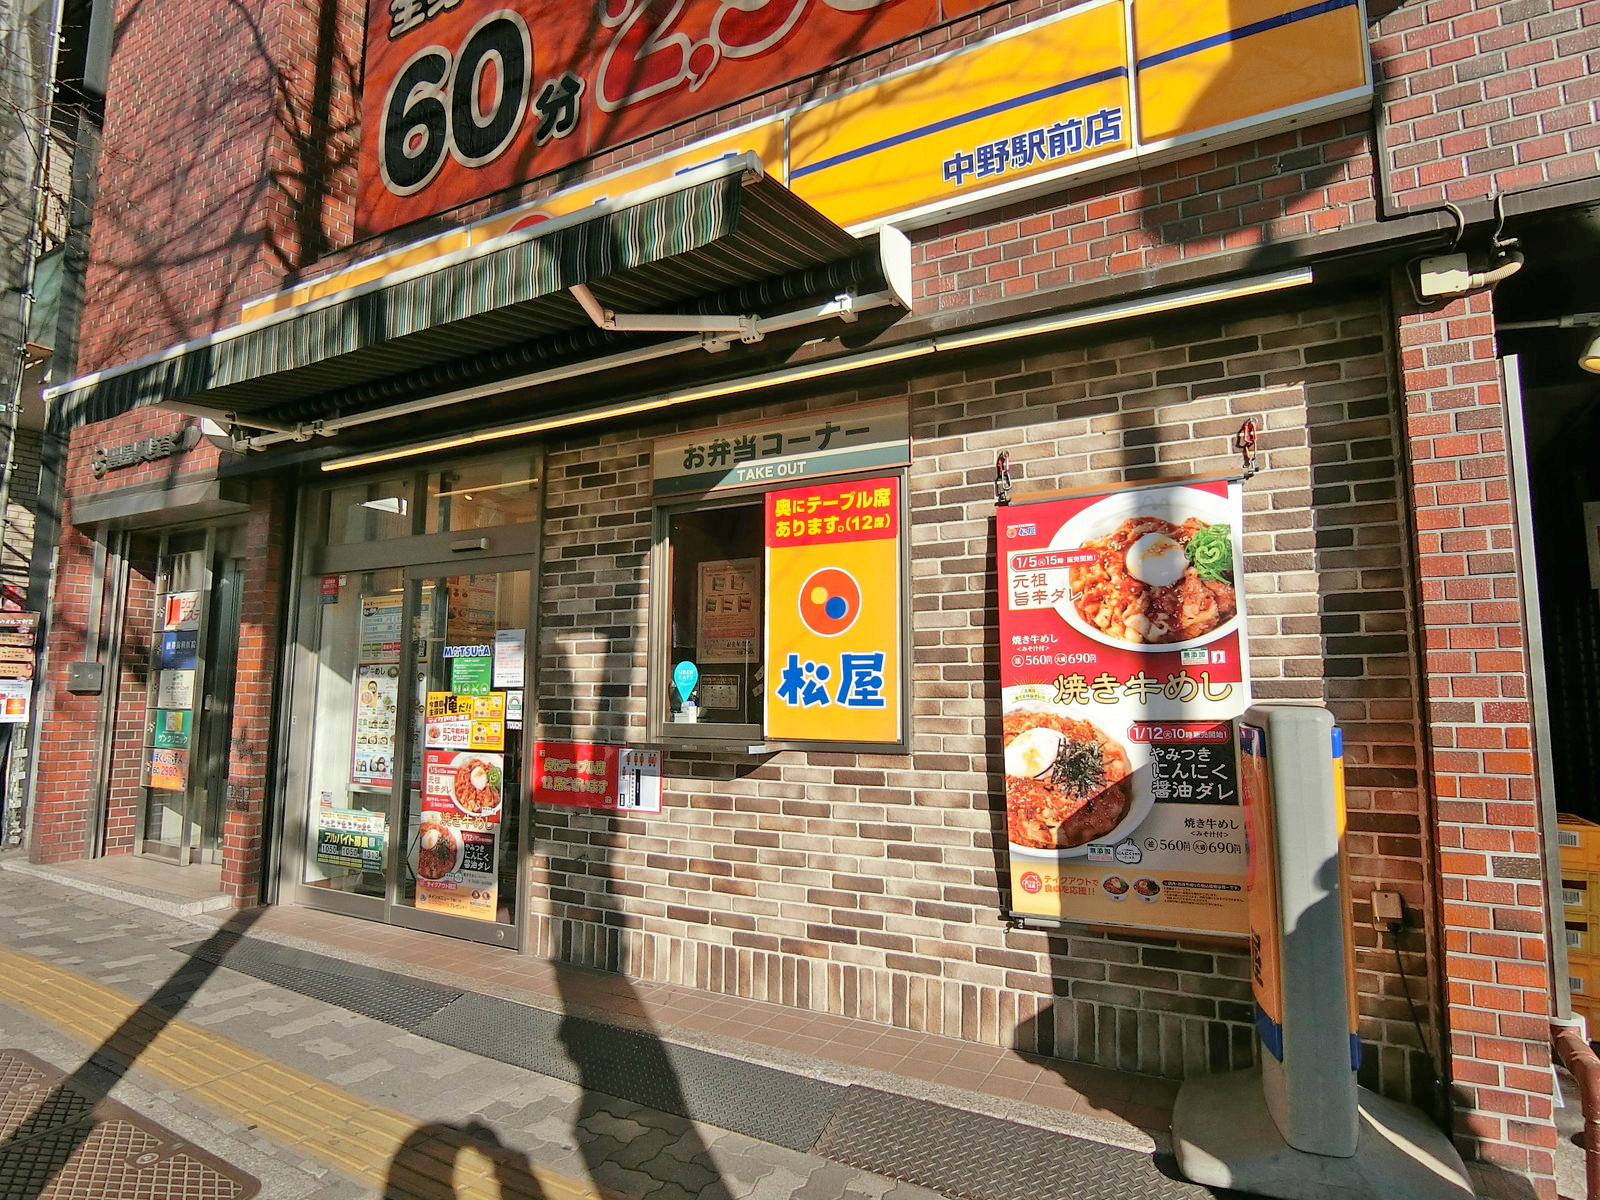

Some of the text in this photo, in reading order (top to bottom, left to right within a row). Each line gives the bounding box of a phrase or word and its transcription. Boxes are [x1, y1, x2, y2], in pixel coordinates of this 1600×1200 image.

[942, 106, 1124, 186] 中野駅前店
[683, 421, 871, 470] お弁当コーナー
[736, 462, 807, 482] TAKE OUT
[775, 488, 891, 518] 奥にテーブル席
[775, 514, 891, 538] あります。(12席)
[1012, 573, 1048, 588] 元祖
[1014, 586, 1083, 606] 旨辛ダレ
[1012, 633, 1059, 645] 焼き牛めし
[443, 645, 491, 658] MATSUYA
[776, 651, 888, 709] 松屋
[1053, 669, 1233, 705] 焼き牛めし
[1150, 746, 1211, 762] やみつき
[543, 757, 607, 775] 奥にテーブル席
[1152, 763, 1228, 780] にんにく
[541, 775, 609, 794] 12席ございます
[1151, 781, 1234, 800] 醤油ダレ
[439, 812, 495, 831] 焼き牛めし
[1184, 817, 1240, 830] 焼き牛めし
[324, 832, 369, 849] アルバイト募集
[464, 851, 489, 861] にんにく
[1043, 875, 1099, 887] テイクアウトで
